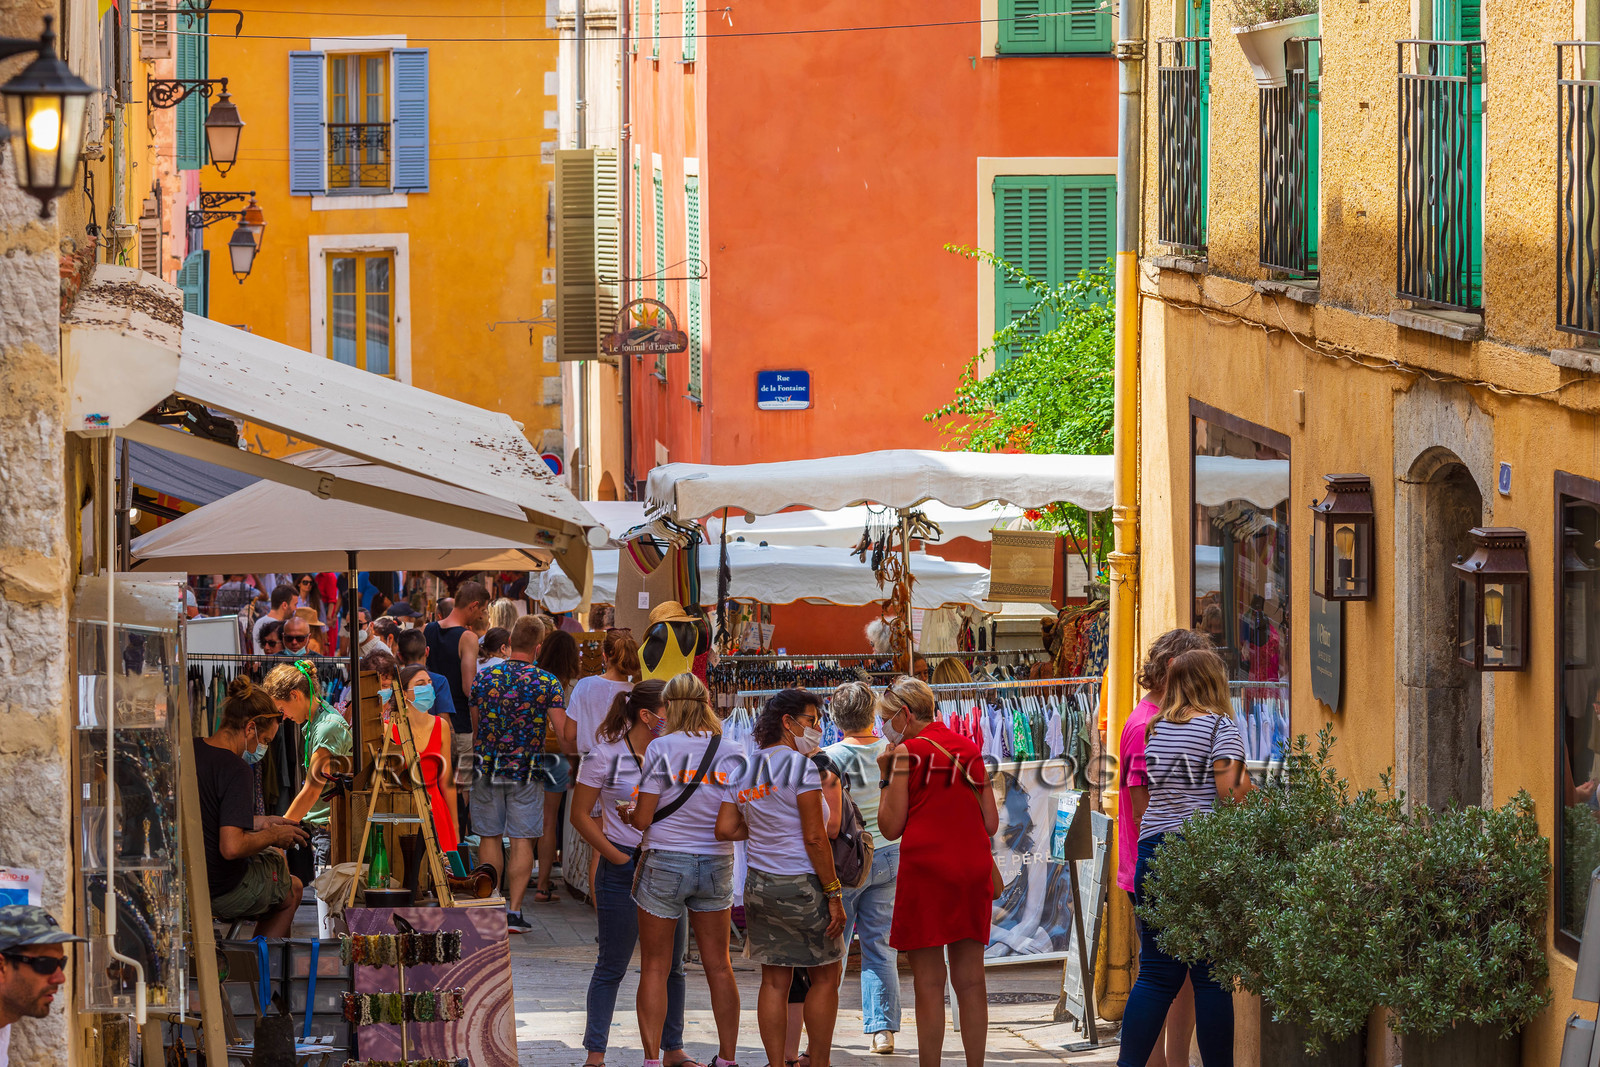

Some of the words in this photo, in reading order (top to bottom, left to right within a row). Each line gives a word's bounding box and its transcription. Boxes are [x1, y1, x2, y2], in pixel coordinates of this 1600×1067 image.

[609, 344, 618, 352] Le
[678, 769, 728, 785] STAFF
[737, 781, 771, 804] STAFF
